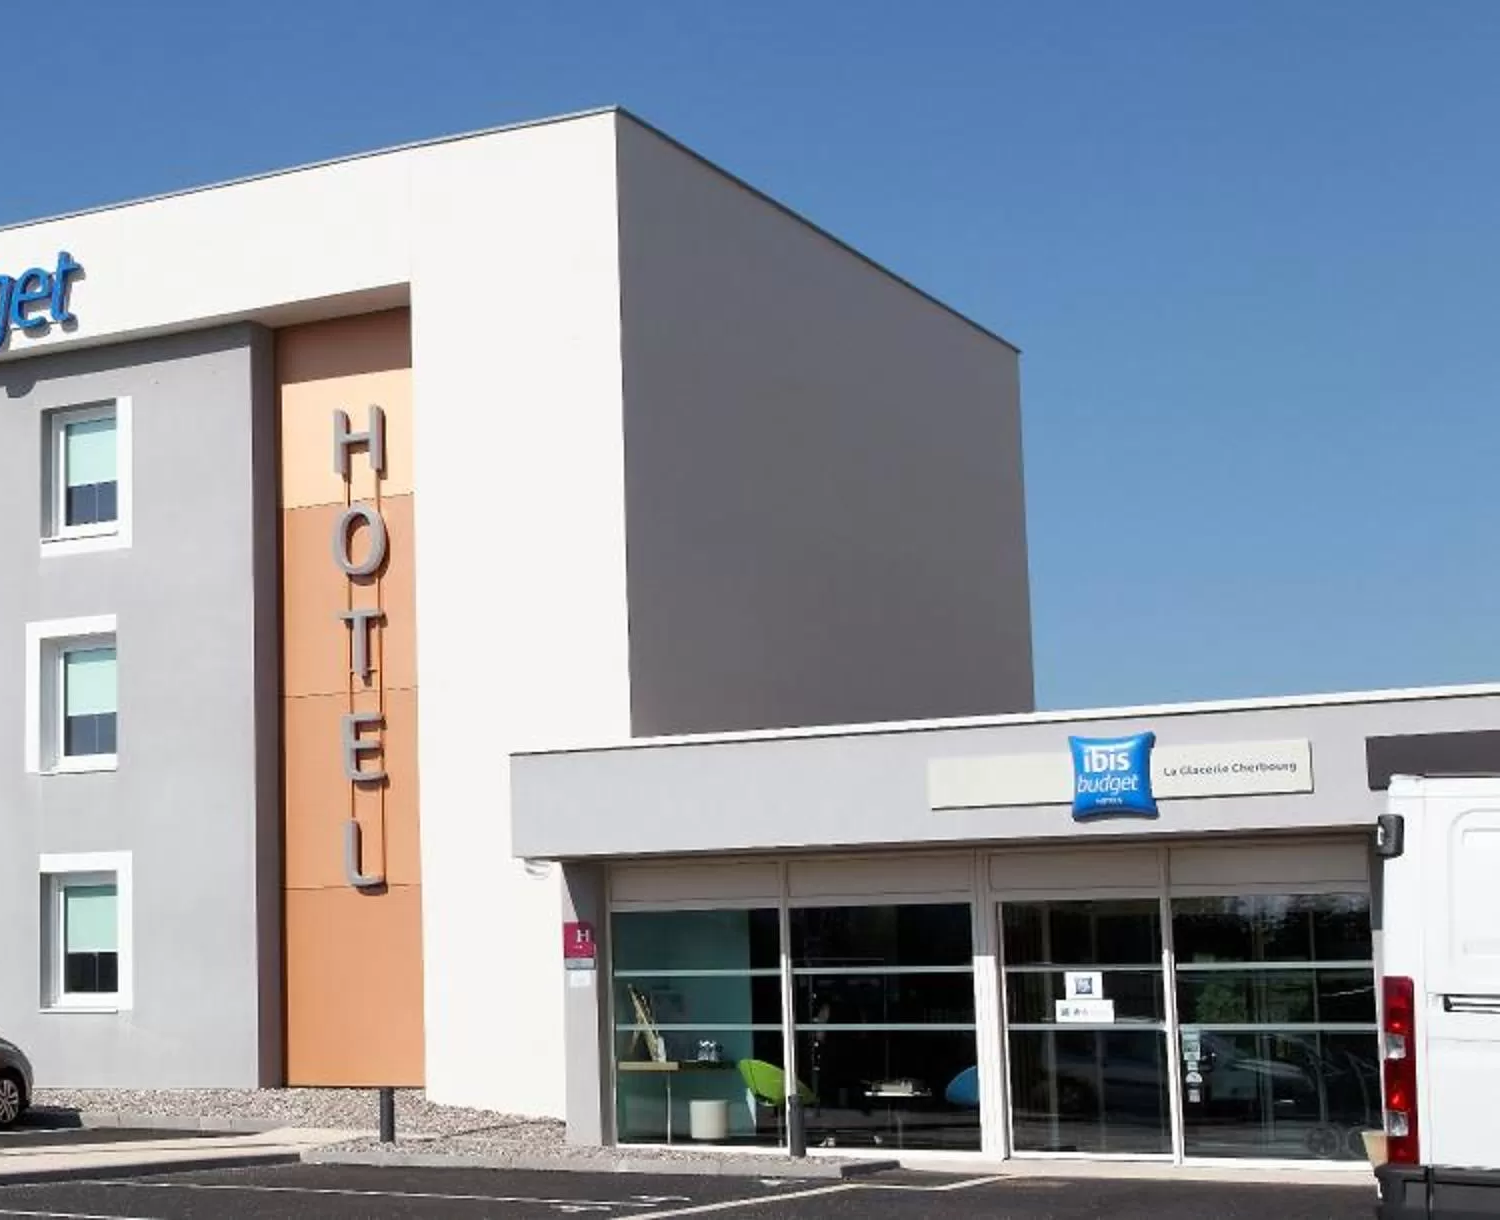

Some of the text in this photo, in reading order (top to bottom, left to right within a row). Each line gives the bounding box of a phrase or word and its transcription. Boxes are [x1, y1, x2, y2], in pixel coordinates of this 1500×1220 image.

[332, 403, 387, 887] HOTEL
[1083, 746, 1131, 773] ibis
[1163, 766, 1177, 777] La
[1231, 762, 1297, 775] Cherbourg
[1077, 773, 1139, 797] budget
[576, 929, 589, 943] H
